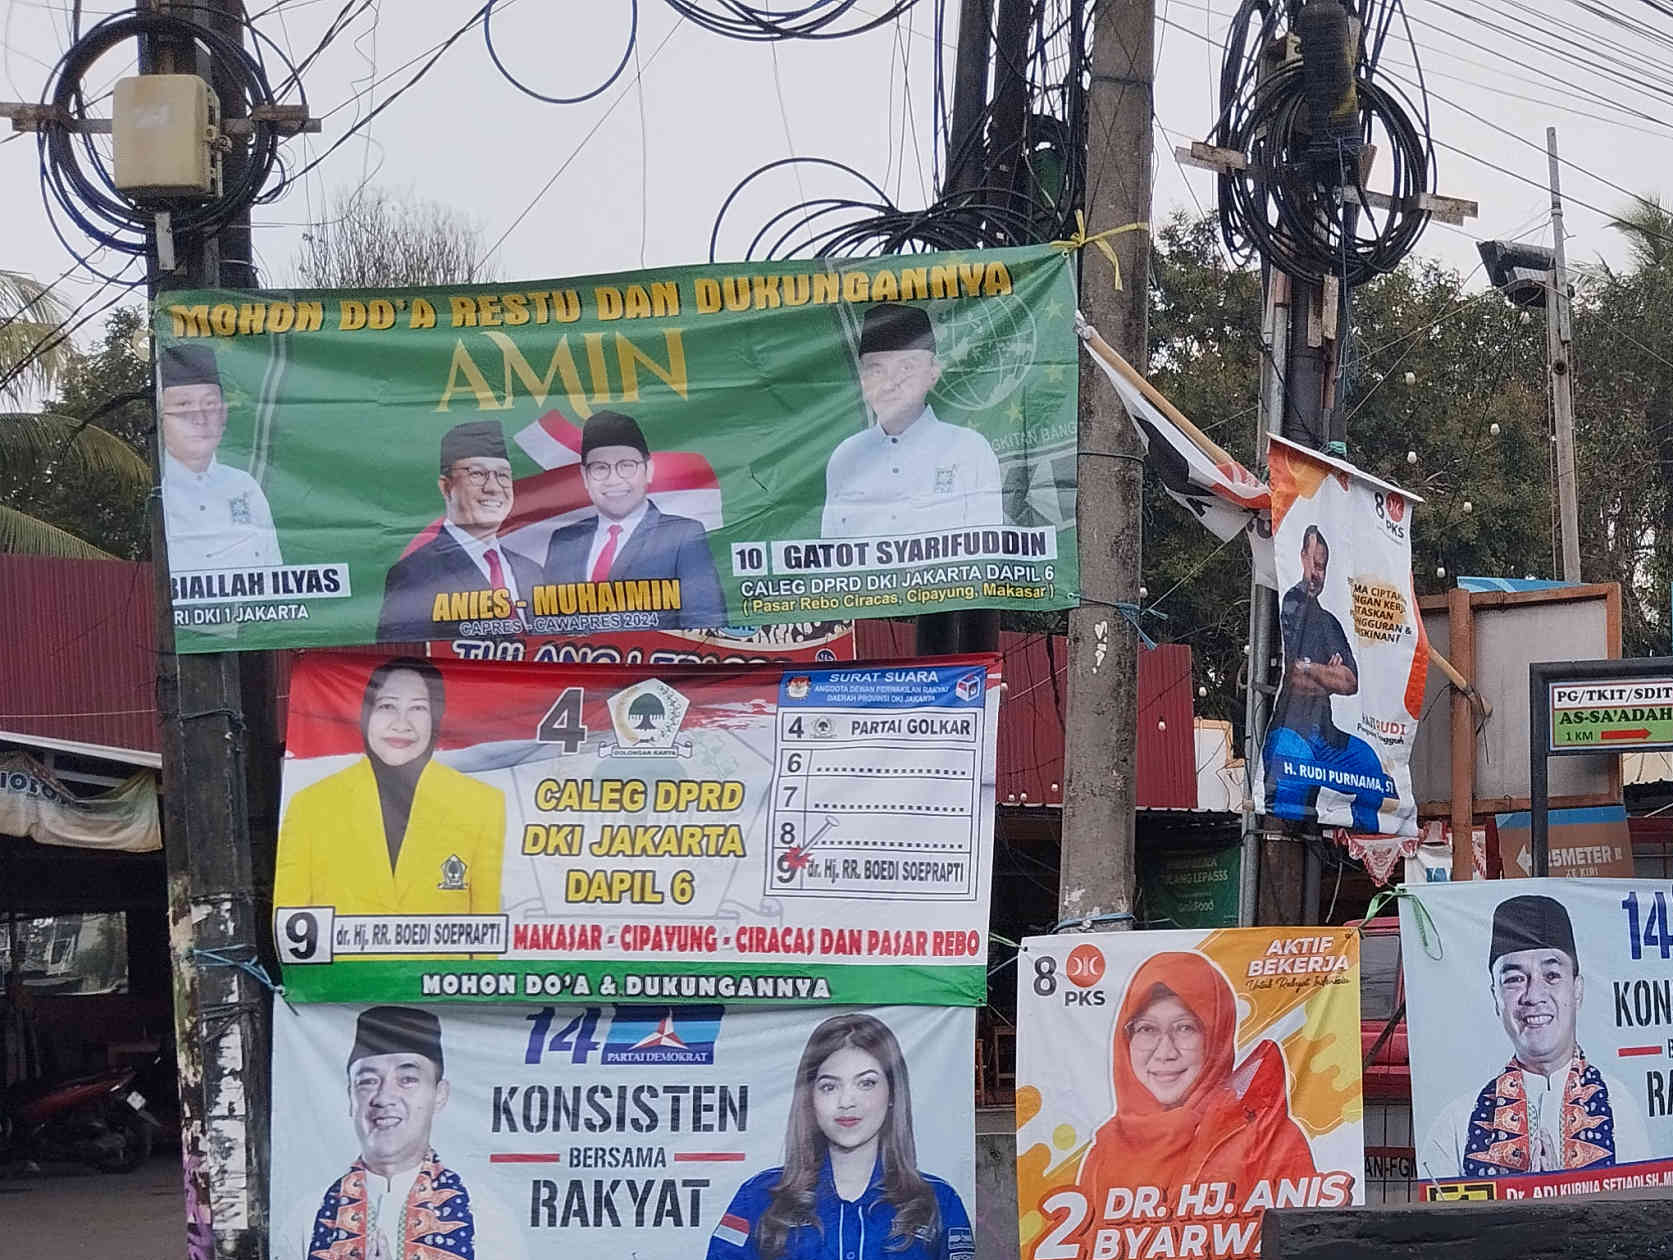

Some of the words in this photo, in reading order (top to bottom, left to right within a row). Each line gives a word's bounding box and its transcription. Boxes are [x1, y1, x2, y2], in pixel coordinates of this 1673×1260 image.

[171, 303, 323, 337] MOHON
[339, 298, 436, 331] DO'A
[450, 289, 582, 328] RESTU
[598, 282, 680, 322] DAN
[695, 262, 1013, 315] DUKUNGANNYA
[433, 327, 688, 418] AMIN
[1374, 491, 1385, 520] 8
[736, 548, 763, 571] 10
[784, 541, 869, 571] GATOT
[876, 530, 1047, 566] SYARIFUDDIN
[272, 568, 341, 595] ILYAS
[741, 579, 805, 597] CALEG
[811, 576, 861, 594] DPRD
[867, 573, 897, 591] DKI
[902, 565, 982, 588] JAKARTA
[986, 564, 1041, 582] DAPIL
[1043, 565, 1055, 581] 6
[433, 589, 511, 622] ANIES
[532, 580, 681, 616] MUHAIMIN
[753, 598, 797, 614] Pasar
[801, 596, 838, 612] Rebo
[906, 583, 978, 605] Cipayung,
[983, 582, 1046, 599] Makasar
[194, 608, 221, 624] DKI
[235, 604, 309, 623] JAKARTA
[459, 619, 521, 636] CAPRES
[535, 614, 621, 633] CAWAPRES
[624, 612, 659, 627] 2024
[829, 672, 887, 683] SURAT
[889, 671, 938, 683] SUARA
[1556, 685, 1673, 704] PG/TKIT/SDIT
[537, 687, 587, 755] 4
[788, 716, 804, 739] 4
[850, 718, 902, 736] PARTAI
[906, 718, 971, 737] GOLKAR
[1559, 706, 1673, 727] AS-SA'ADAH
[1565, 730, 1573, 742] 1
[1575, 730, 1594, 742] KM
[787, 752, 802, 774] 6
[1283, 761, 1297, 776] H.
[1300, 764, 1326, 782] RUDI
[1329, 768, 1385, 792] PURNAMA,
[536, 779, 646, 812] CALEG
[656, 780, 746, 813] DPRD
[783, 785, 798, 809] 7
[522, 823, 583, 856] DKI
[590, 824, 747, 858] JAKARTA
[779, 821, 796, 845] 8
[565, 869, 664, 905] DAPIL
[671, 870, 695, 905] 6
[285, 911, 319, 960] 9
[336, 926, 351, 946] dr.
[353, 924, 369, 952] Hj.
[372, 925, 392, 946] RR.
[394, 924, 431, 946] BOEDI
[433, 922, 501, 946] SOEPRAPTI
[513, 923, 601, 952] MAKASAR
[619, 924, 717, 953] CIPAYUNG
[735, 926, 815, 956] CIRACAS
[819, 928, 863, 956] DAN
[866, 929, 928, 957] PASAR
[932, 930, 981, 957] REBO
[1266, 935, 1335, 956] AKTIF
[1033, 955, 1058, 998] 8
[1247, 954, 1349, 977] BEKERJA
[422, 974, 518, 997] MOHON
[525, 974, 591, 996] DO'A
[599, 975, 618, 996] &
[625, 974, 832, 999] DUKUNGANNYA
[1063, 989, 1106, 1008] PKS
[524, 1006, 602, 1064] 14
[607, 1051, 645, 1062] PARTAI
[645, 1051, 708, 1062] DEMOKRAT
[491, 1084, 749, 1134] KONSISTEN
[568, 1146, 667, 1169] BERSAMA
[530, 1178, 711, 1228] RAKYAT
[1102, 1185, 1167, 1222] DR.
[1176, 1181, 1235, 1218] HJ.
[1242, 1173, 1347, 1210] ANIS
